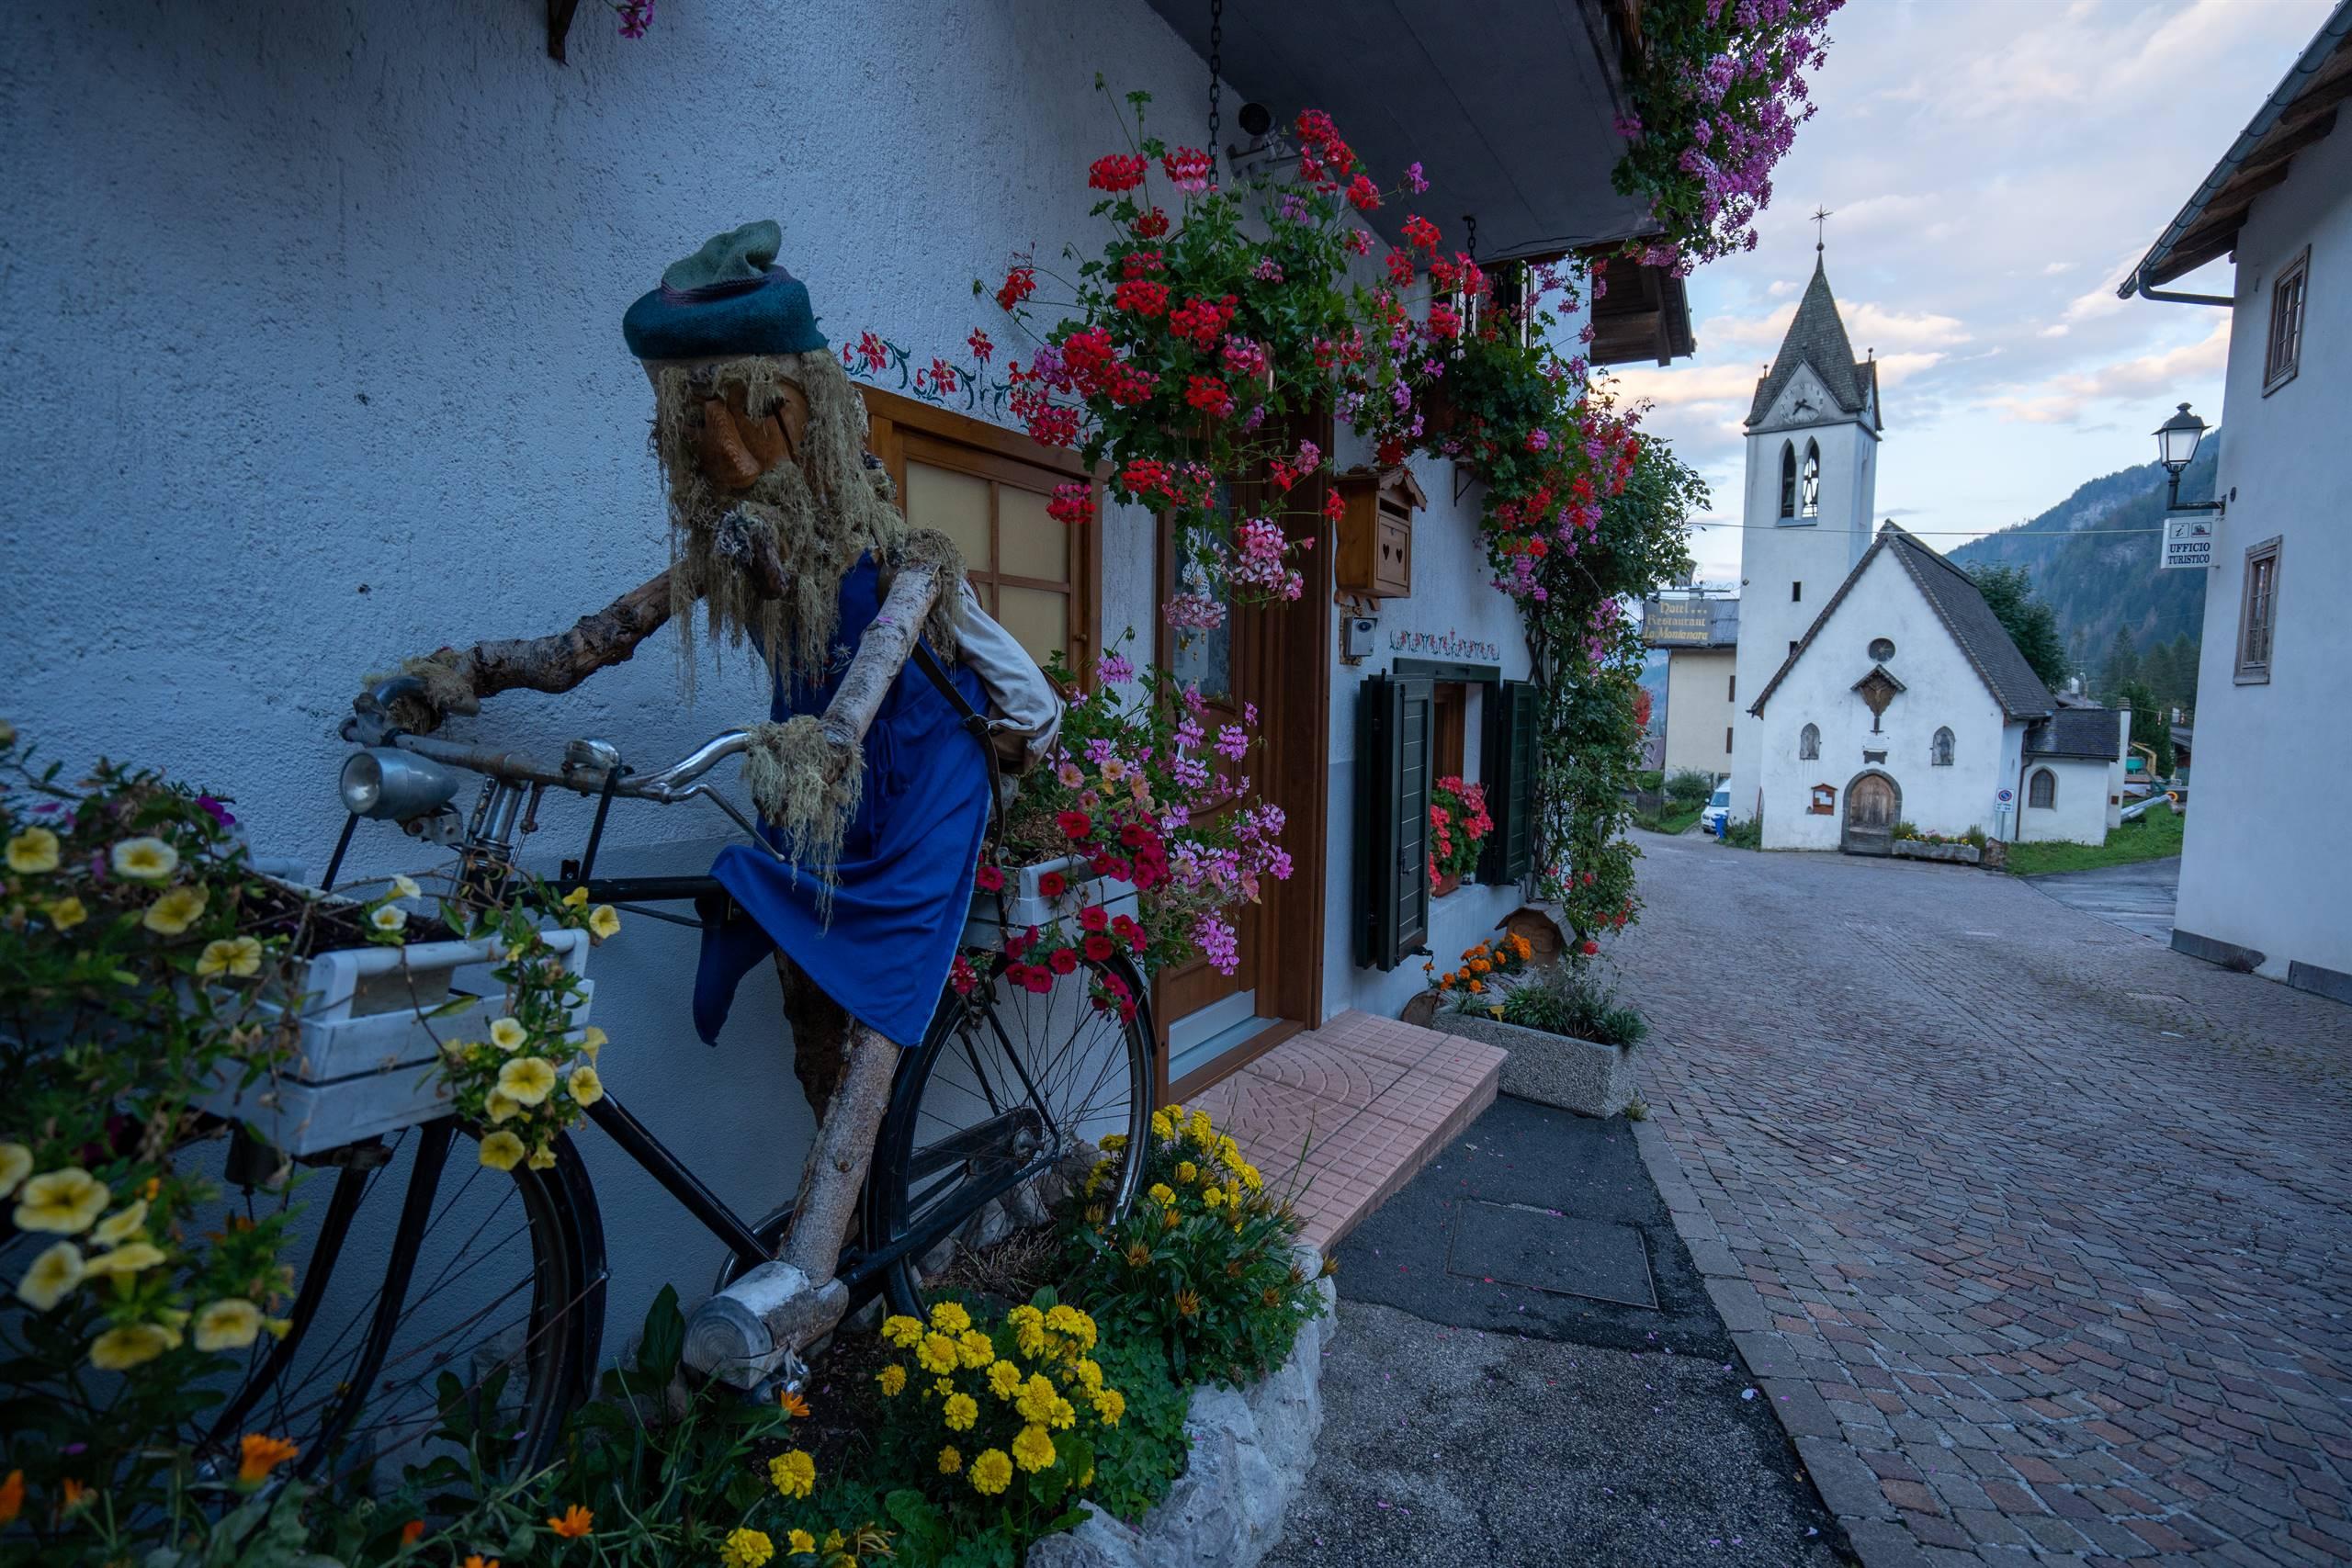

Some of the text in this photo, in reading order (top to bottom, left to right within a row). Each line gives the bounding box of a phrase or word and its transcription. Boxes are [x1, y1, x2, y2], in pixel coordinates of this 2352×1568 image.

[2169, 542, 2211, 553] UFFICIO
[2168, 554, 2210, 565] TURISTICO
[1660, 601, 1689, 615] Hotel
[1647, 614, 1706, 626] Restaurant
[1659, 626, 1710, 640] Montanara
